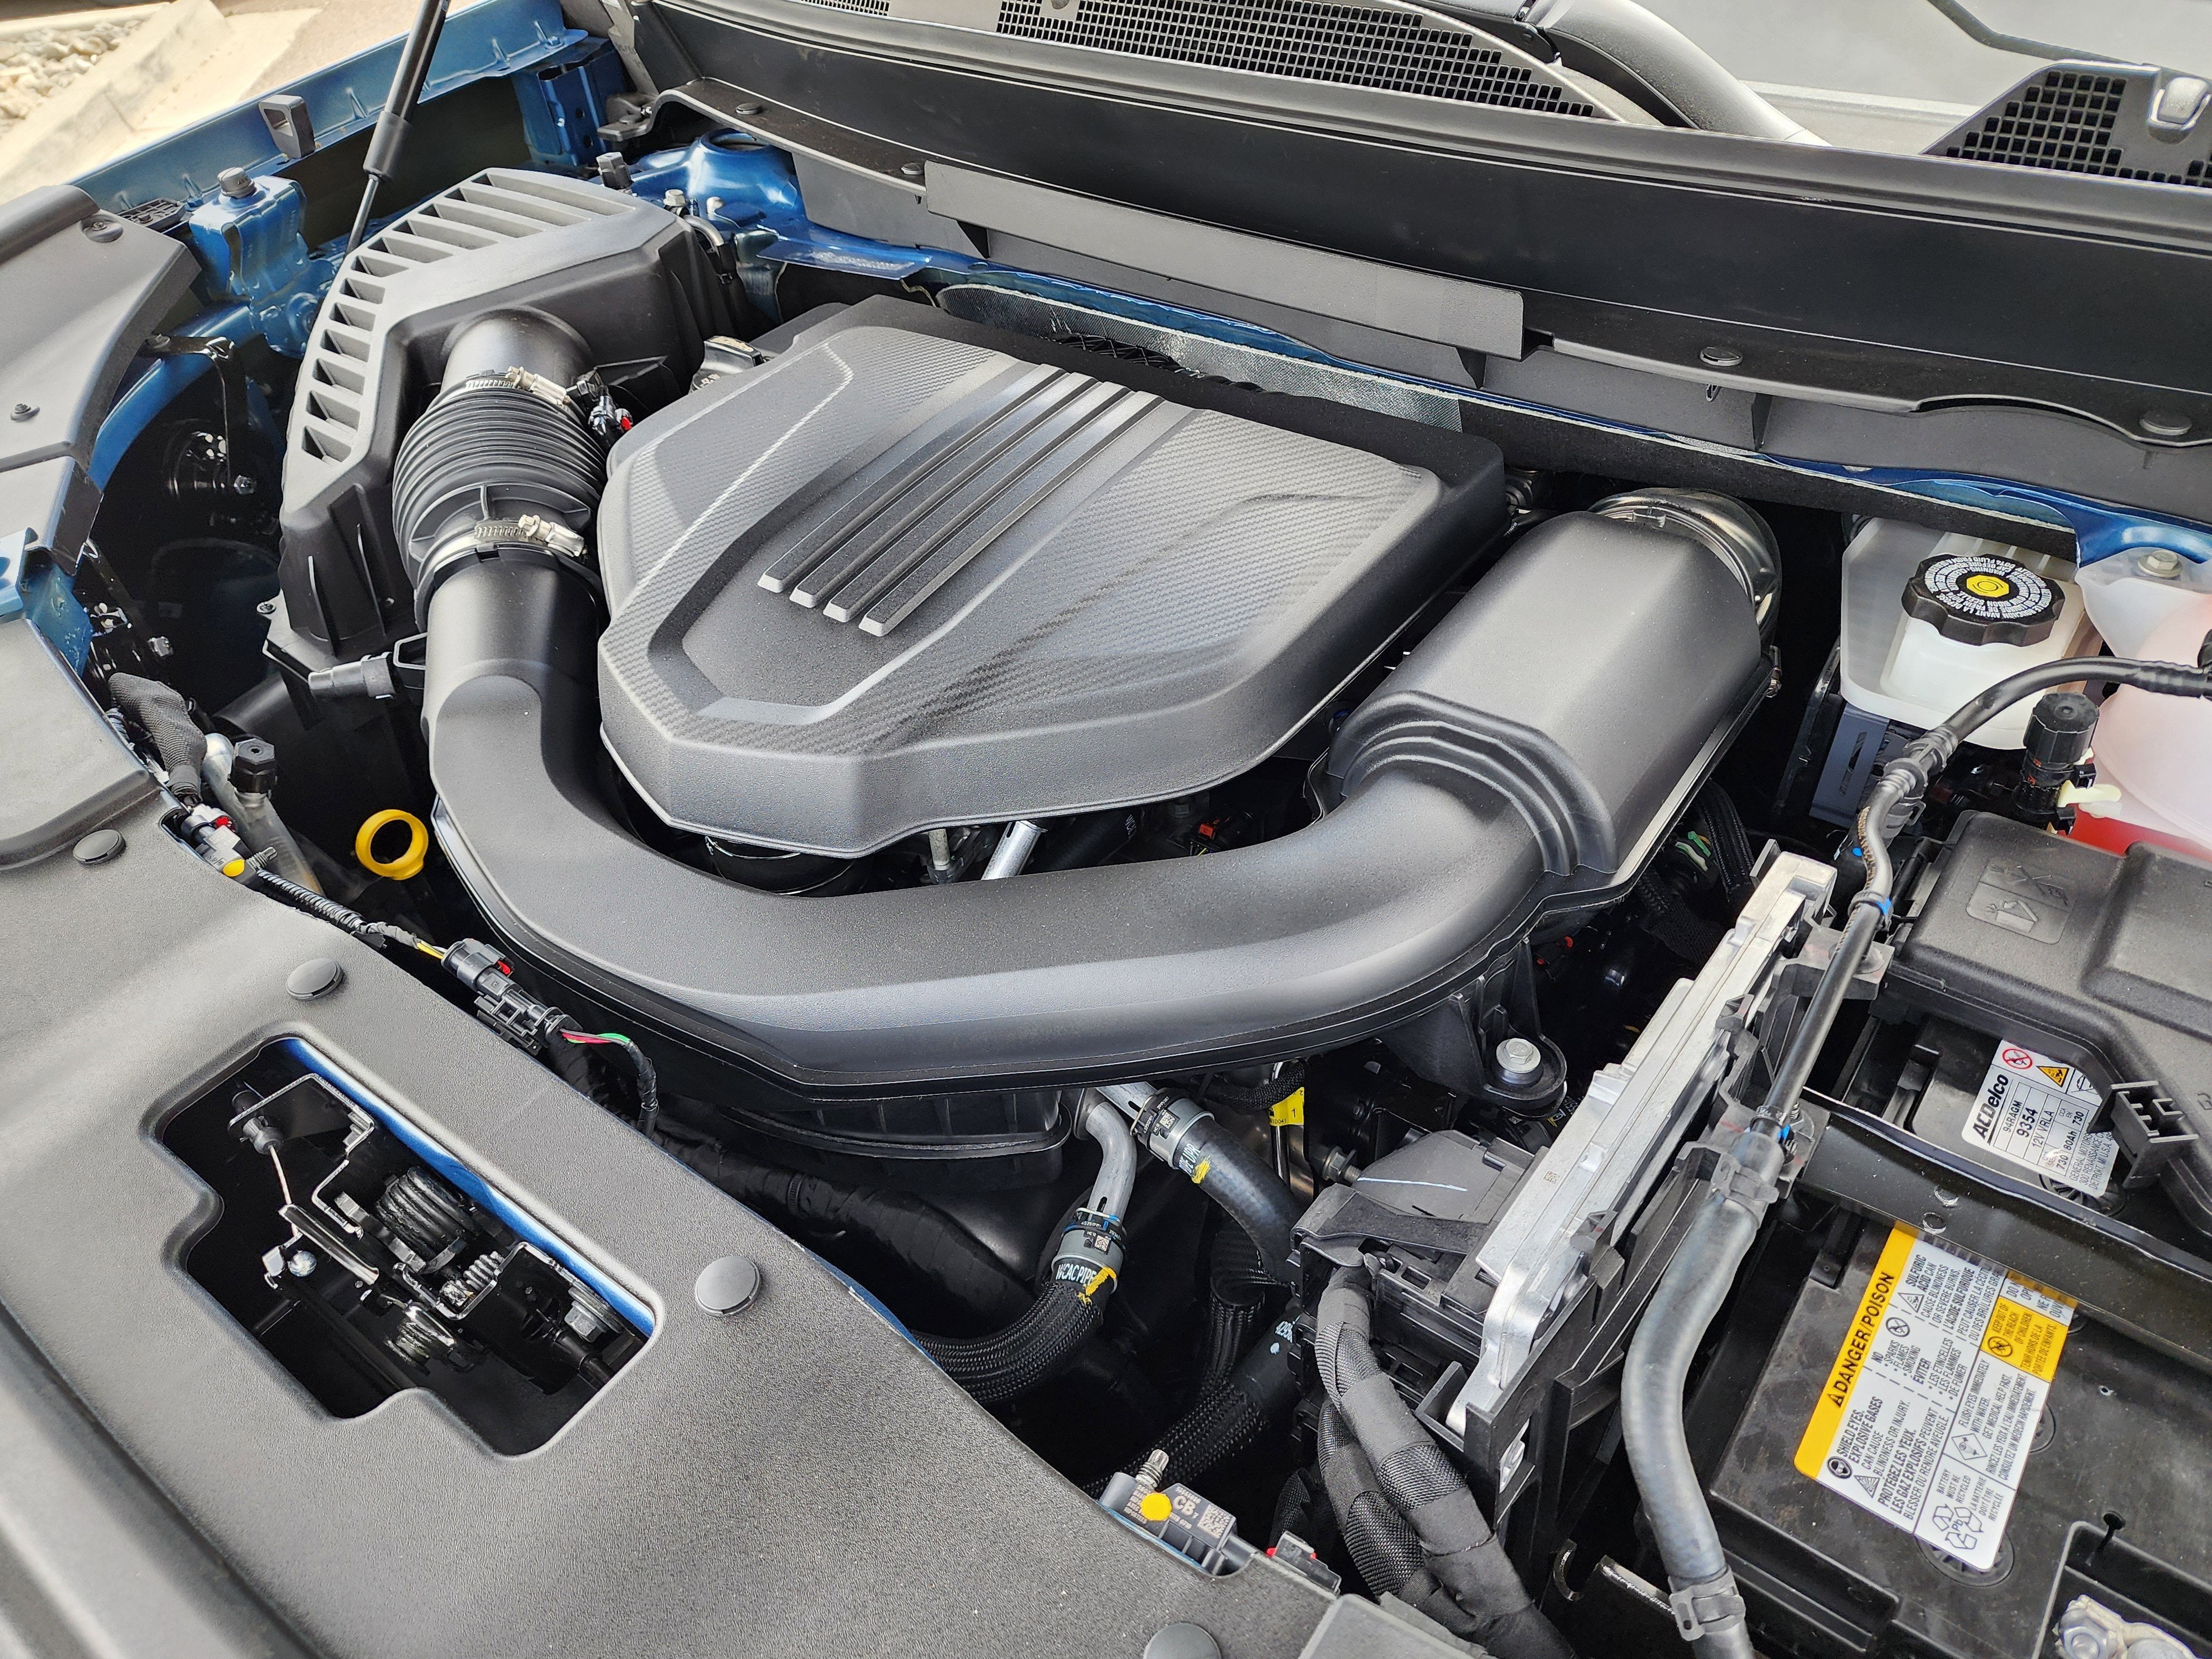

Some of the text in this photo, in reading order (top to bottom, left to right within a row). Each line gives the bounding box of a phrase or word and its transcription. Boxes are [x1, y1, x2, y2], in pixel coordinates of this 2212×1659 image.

[1995, 564, 2012, 573] CAP
[1959, 605, 1975, 614] LA
[1960, 599, 1986, 612] FREIN
[1974, 609, 2002, 619] AVANT
[1291, 1108, 1296, 1118] 1
[1972, 1073, 2010, 1139] ACDelco
[2001, 1099, 2023, 1133] 94RAGM
[2036, 1108, 2055, 1133] VRLA
[2058, 1107, 2067, 1117] CCA
[2071, 1109, 2085, 1126] 730
[2015, 1105, 2039, 1139] 9354
[1183, 1142, 1201, 1163] UPR
[2030, 1131, 2046, 1149] 12V
[2062, 1129, 2078, 1151] 80Ah
[2055, 1153, 2069, 1170] 730
[2068, 1154, 2085, 1182] GENERAL
[2078, 1137, 2103, 1186] 300 RENAISSANCE
[2088, 1163, 2105, 1190] DETROIT,
[1904, 1253, 1927, 1288] SULFURIC
[1915, 1261, 1937, 1293] ACID CAN
[1919, 1262, 1949, 1319] CAUSE BLINDNESS
[1931, 1266, 1961, 1324] OR SEVERE BURNS.
[1942, 1266, 1975, 1331] L'ACIDE SULFURIQUE
[1971, 1284, 1984, 1296] LA
[2006, 1285, 2020, 1298] DO
[2036, 1298, 2049, 1311] NE
[1963, 1293, 1981, 1320] CAUSER
[1970, 1284, 1996, 1342] OU DES BRÛLURES
[1990, 1301, 2010, 1334] KEEP OUT OF
[1832, 1269, 1895, 1395] DANGER/POISON
[1956, 1317, 1971, 1337] PEUT
[2002, 1311, 2020, 1339] THE REACH
[2014, 1310, 2033, 1345] OF CHILDREN.
[1870, 1350, 1885, 1364] NO
[1882, 1338, 1901, 1365] SPARKS
[1892, 1343, 1910, 1369] FLAMES
[1902, 1344, 1922, 1375] SMOKING
[1927, 1335, 1954, 1387] LES ÉTINCELLES
[2020, 1323, 2043, 1371] TENIR HORS DE LA
[2038, 1345, 2049, 1357] DE
[1909, 1355, 1932, 1385] ÉVITER
[1937, 1346, 1963, 1392] LES FLAMMES
[2030, 1353, 2047, 1376] PORTÉE
[1947, 1362, 1968, 1397] DE FUMER
[1957, 1358, 1990, 1428] FLUSH EYES IMMEDIATELY
[1969, 1394, 1991, 1434] WITH WATER.
[1981, 1371, 2013, 1441] GET MEDICAL HELP FAST.
[2001, 1410, 2015, 1428] L'EAU
[1835, 1406, 1866, 1458] SHIELD EYES.
[1847, 1394, 1884, 1465] EXPLOSIVE GASES
[1872, 1397, 1911, 1477] BLINDNESS OR INJURY.
[1995, 1428, 2008, 1446] YEUX
[1997, 1387, 2037, 1481] CONSULTEZ UN MÉDECIN RAPIDEMENT.
[1860, 1429, 1884, 1471] CAN CAUSE
[1889, 1406, 1939, 1515] LES GAZ EXPLOSIFS PEUVENT
[1985, 1453, 2001, 1475] RINCEZ
[1991, 1442, 2004, 1457] LES
[1874, 1425, 1917, 1508] PROTÉGEZ LES YEUX.
[1902, 1412, 1950, 1521] BLESSER OU RENDRE AVEUGLE.
[1936, 1468, 1952, 1495] BATTERY
[1945, 1473, 1960, 1500] MUST BE
[1955, 1474, 1972, 1505] RECYCLED
[1968, 1475, 1987, 1512] LA BATTERIE
[1174, 1495, 1197, 1516] CB
[1978, 1485, 1995, 1517] DOIT ÊTRE
[1951, 1516, 1964, 1532] Pb
